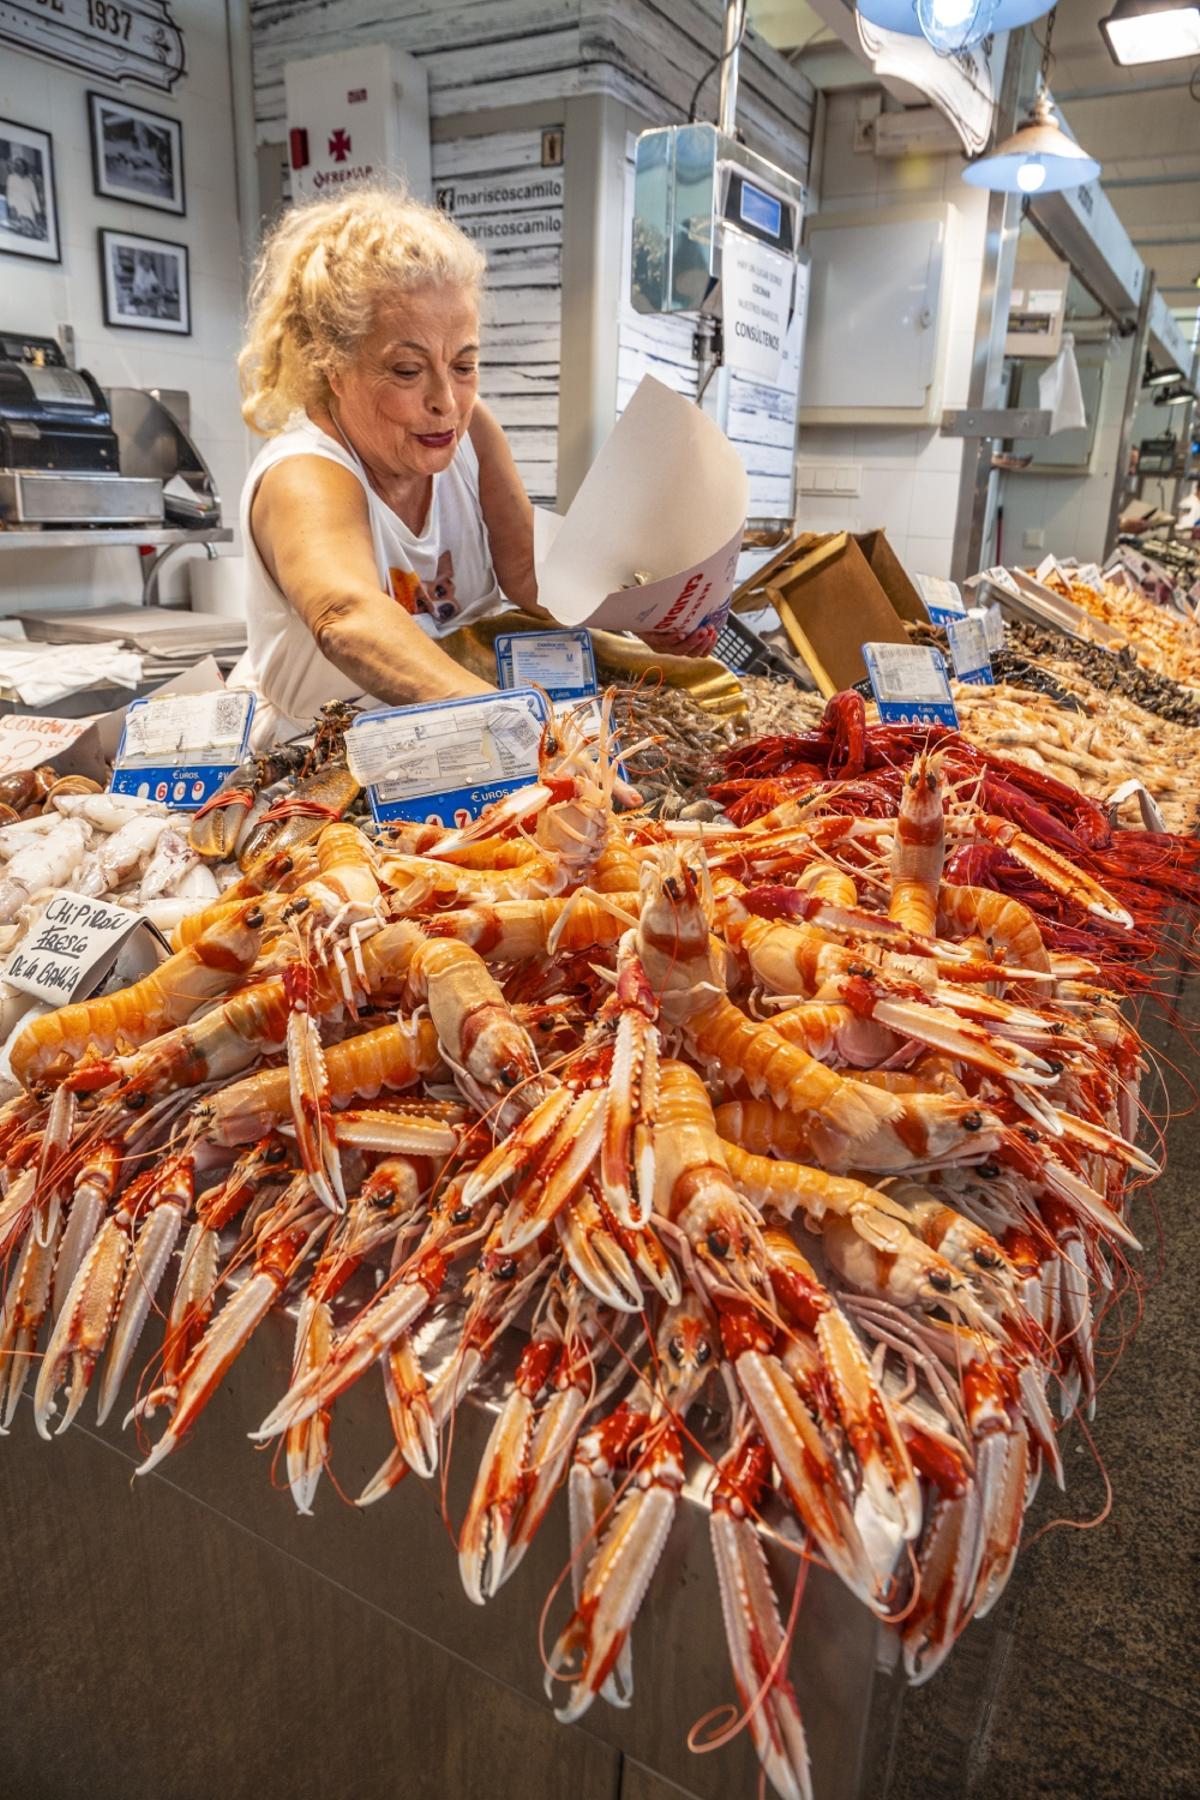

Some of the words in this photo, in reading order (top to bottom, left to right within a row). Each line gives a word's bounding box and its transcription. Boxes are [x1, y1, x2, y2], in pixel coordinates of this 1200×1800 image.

[87, 0, 132, 41] 1937
[456, 181, 562, 206] mariscoscamilo
[653, 573, 704, 630] CALIDAD
